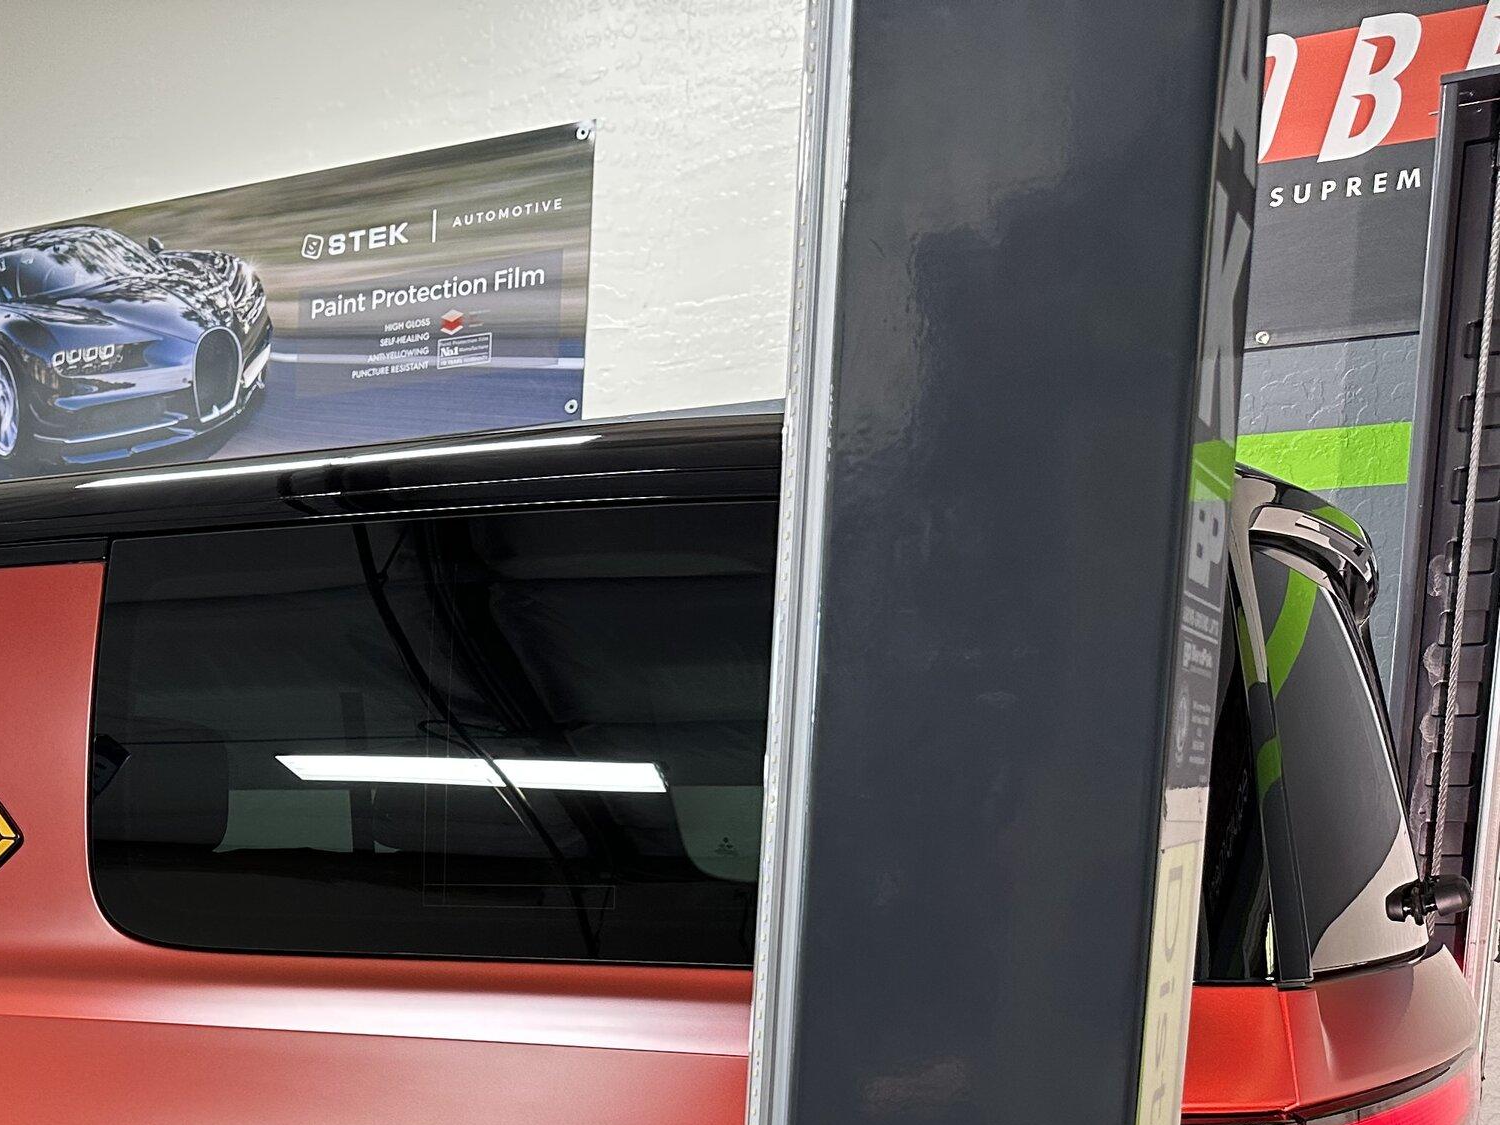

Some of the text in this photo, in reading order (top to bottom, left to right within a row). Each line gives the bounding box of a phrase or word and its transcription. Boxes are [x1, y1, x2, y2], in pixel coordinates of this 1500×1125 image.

[1269, 167, 1422, 208] SUPREM
[328, 198, 563, 256] STEK AUTOMOTIVE
[311, 267, 545, 320] Paint Protection Film
[384, 318, 431, 332] HIGH GLOSS
